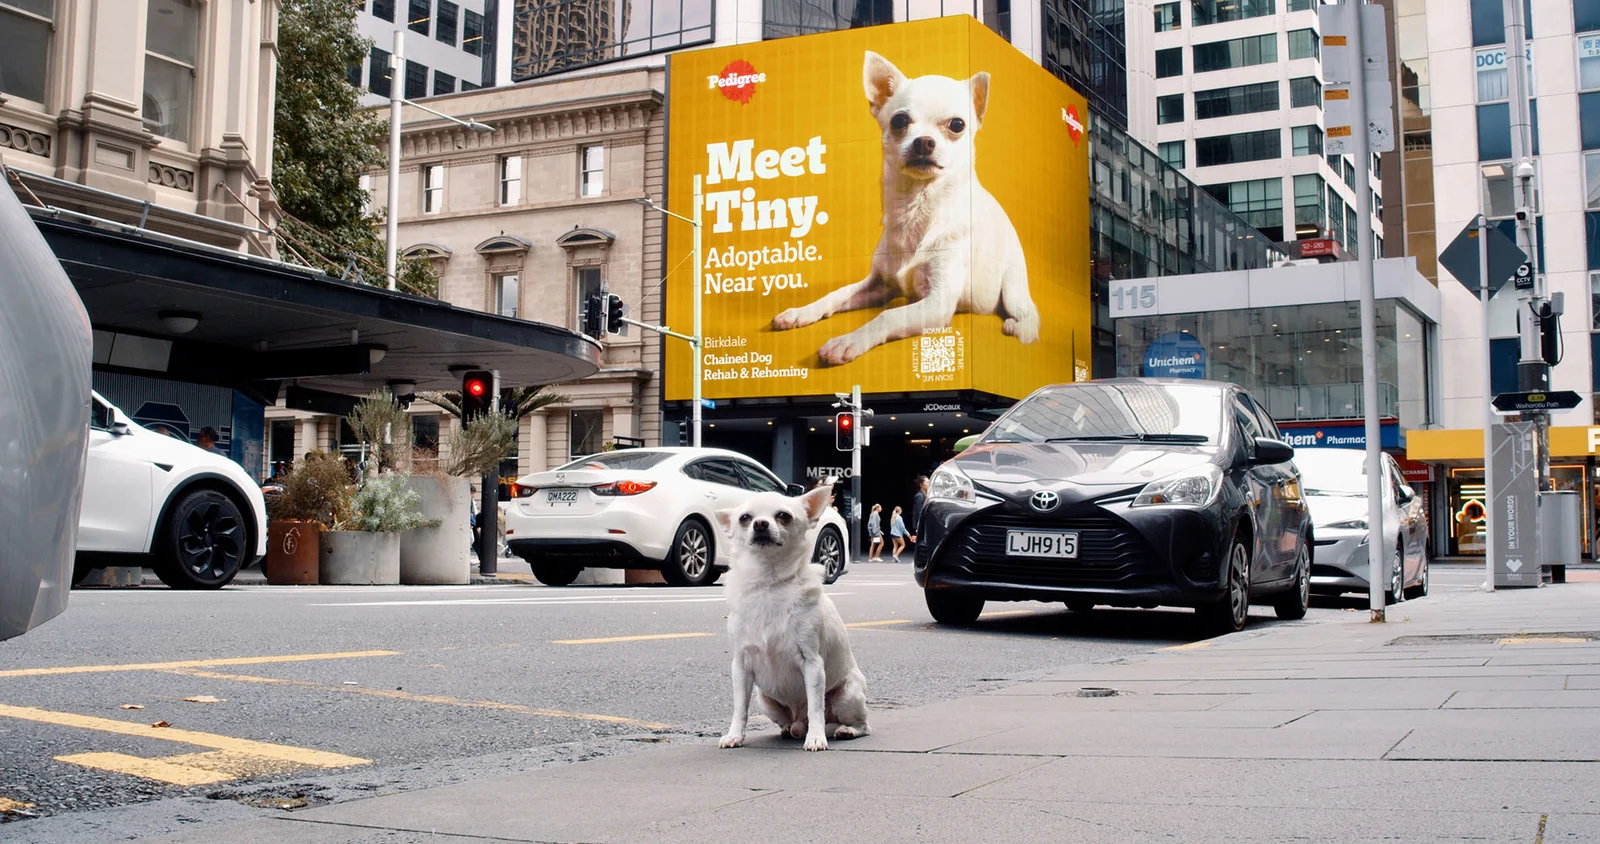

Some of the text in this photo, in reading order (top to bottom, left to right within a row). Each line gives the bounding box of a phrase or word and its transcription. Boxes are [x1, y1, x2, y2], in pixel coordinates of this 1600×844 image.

[1476, 50, 1531, 67] DOCR
[707, 73, 766, 89] Pedigree
[706, 136, 826, 184] Meet
[706, 187, 829, 238] Tiny.
[704, 240, 823, 271] Adoptable.
[704, 273, 808, 296] Near you.
[1112, 285, 1155, 310] 115
[922, 327, 940, 335] SCAN
[704, 336, 747, 348] Birkdale
[912, 339, 919, 350] ME
[704, 352, 773, 365] Chained Dog
[957, 359, 964, 370] ME
[1149, 356, 1195, 367] Unichem
[704, 366, 808, 380] Rehab & Rehoming
[923, 403, 961, 411] JCDecaux
[1281, 432, 1366, 446] hem Pharmac
[807, 467, 853, 478] METRO
[1507, 495, 1515, 520] WORDS
[1507, 521, 1516, 540] YOUR
[1009, 535, 1075, 554] LJH915
[1508, 541, 1516, 549] IN
